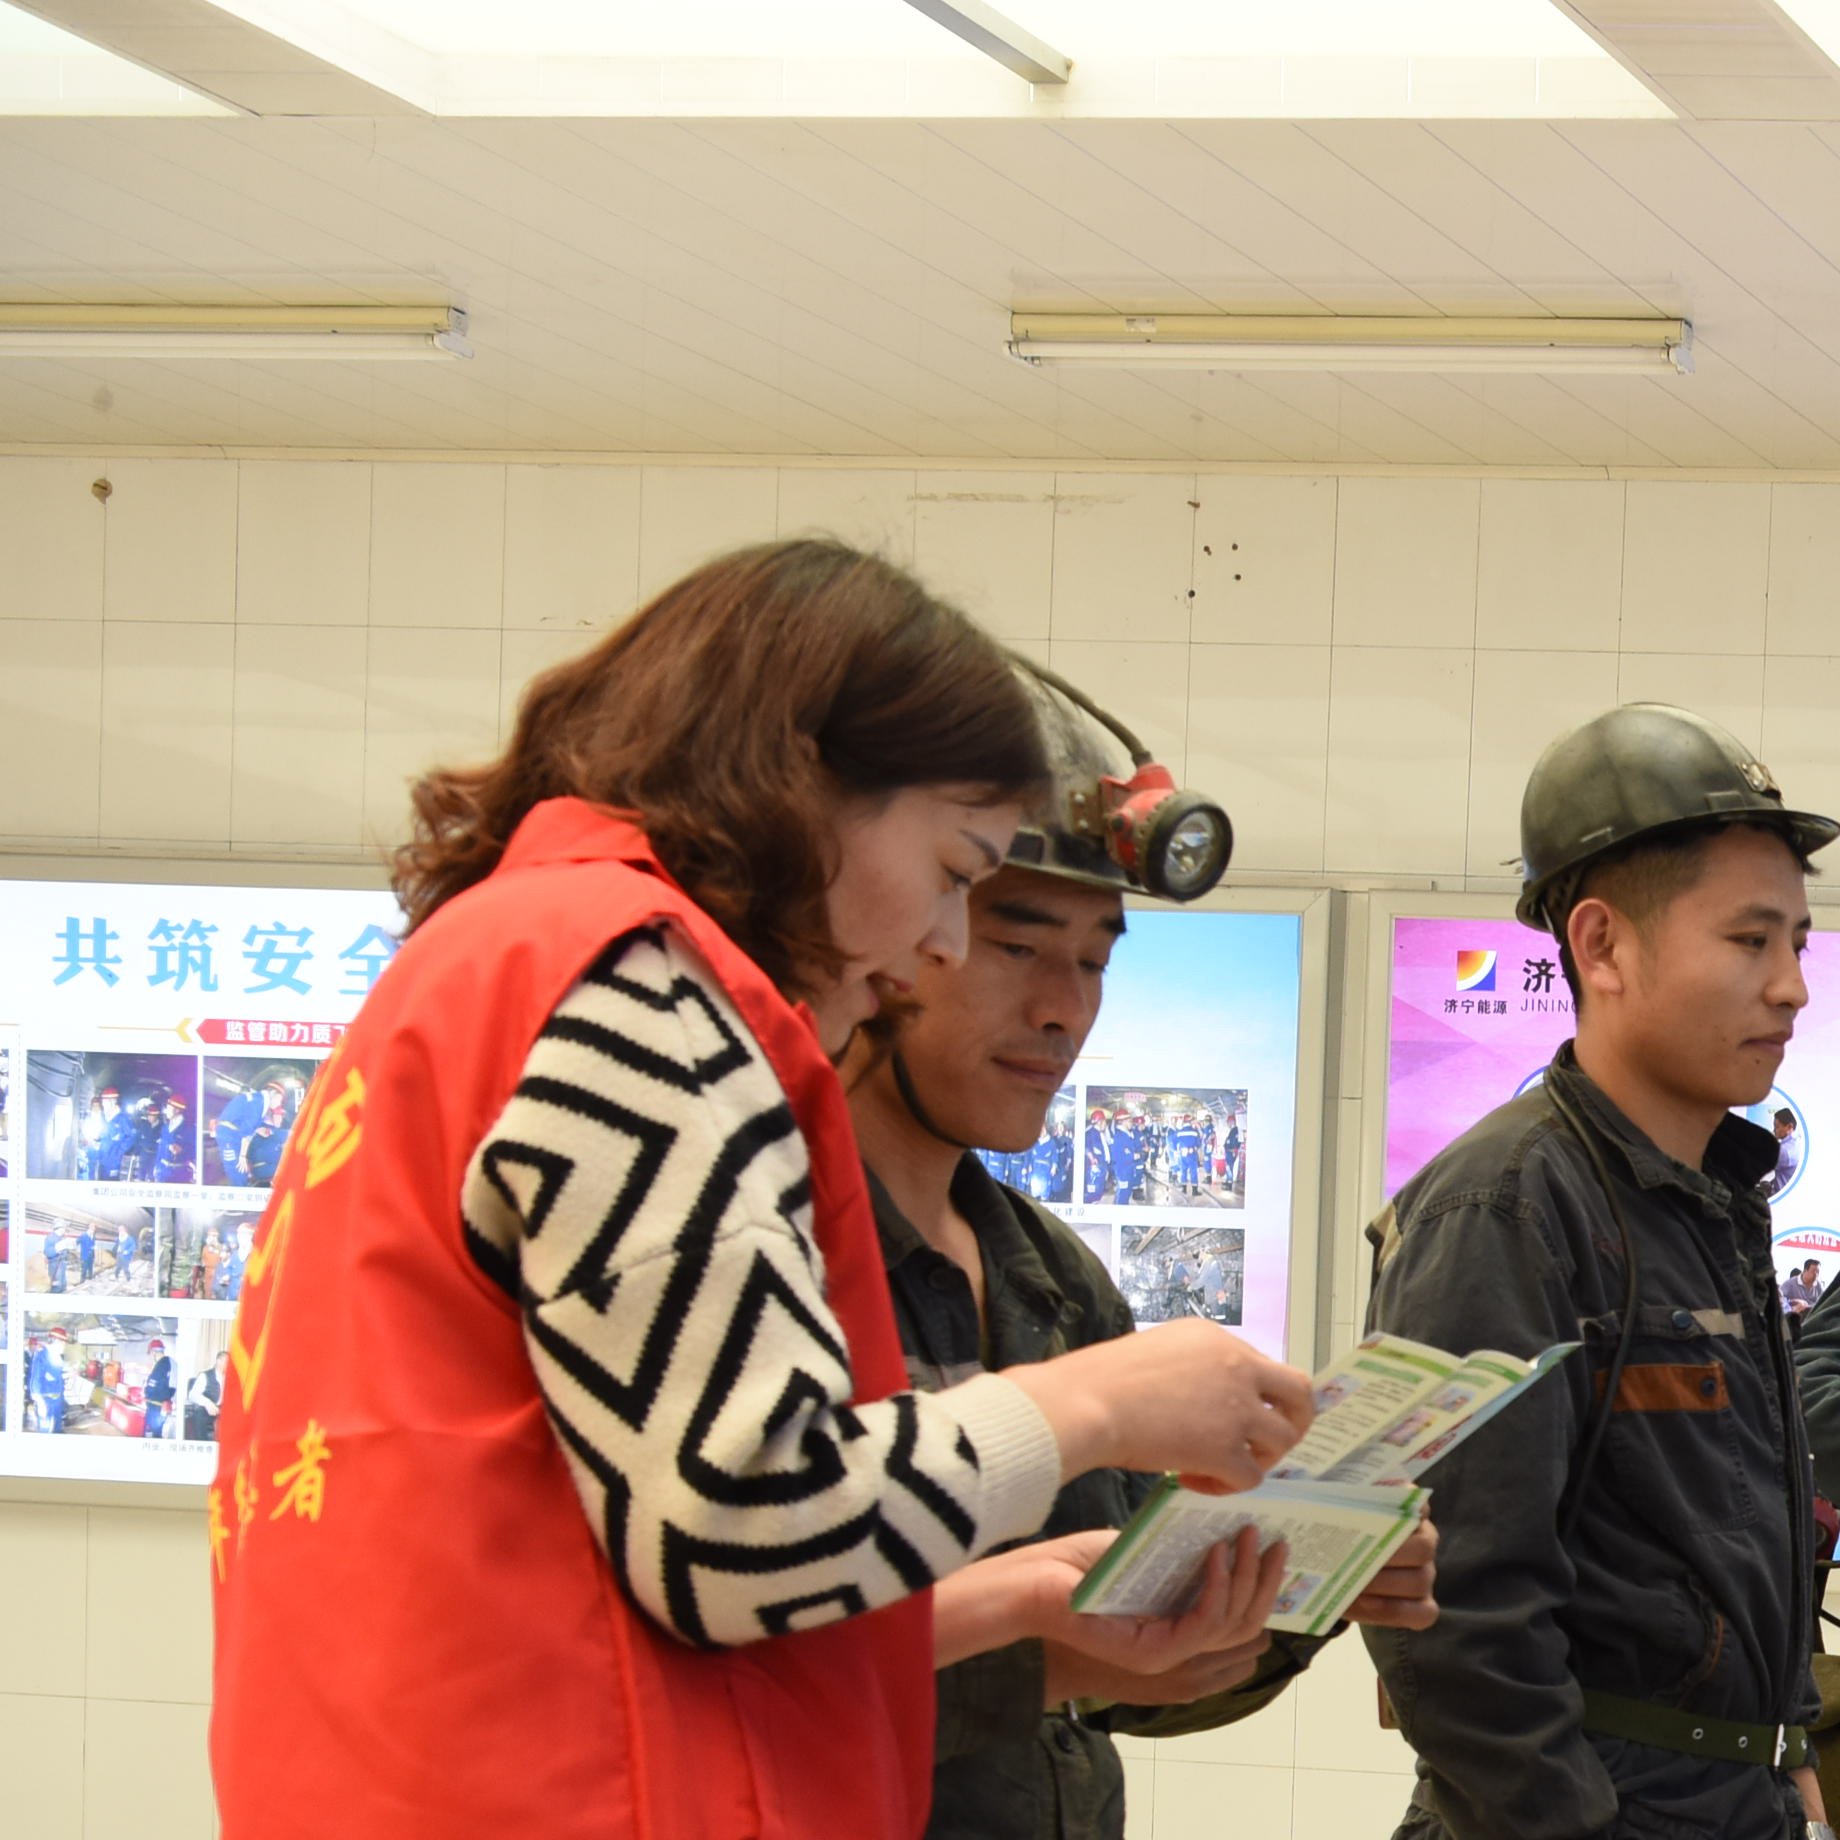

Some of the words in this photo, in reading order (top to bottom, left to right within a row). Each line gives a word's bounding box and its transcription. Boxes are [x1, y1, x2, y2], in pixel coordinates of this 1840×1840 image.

[1523, 958, 1567, 993] 济
[1444, 999, 1507, 1014] 济宁能源
